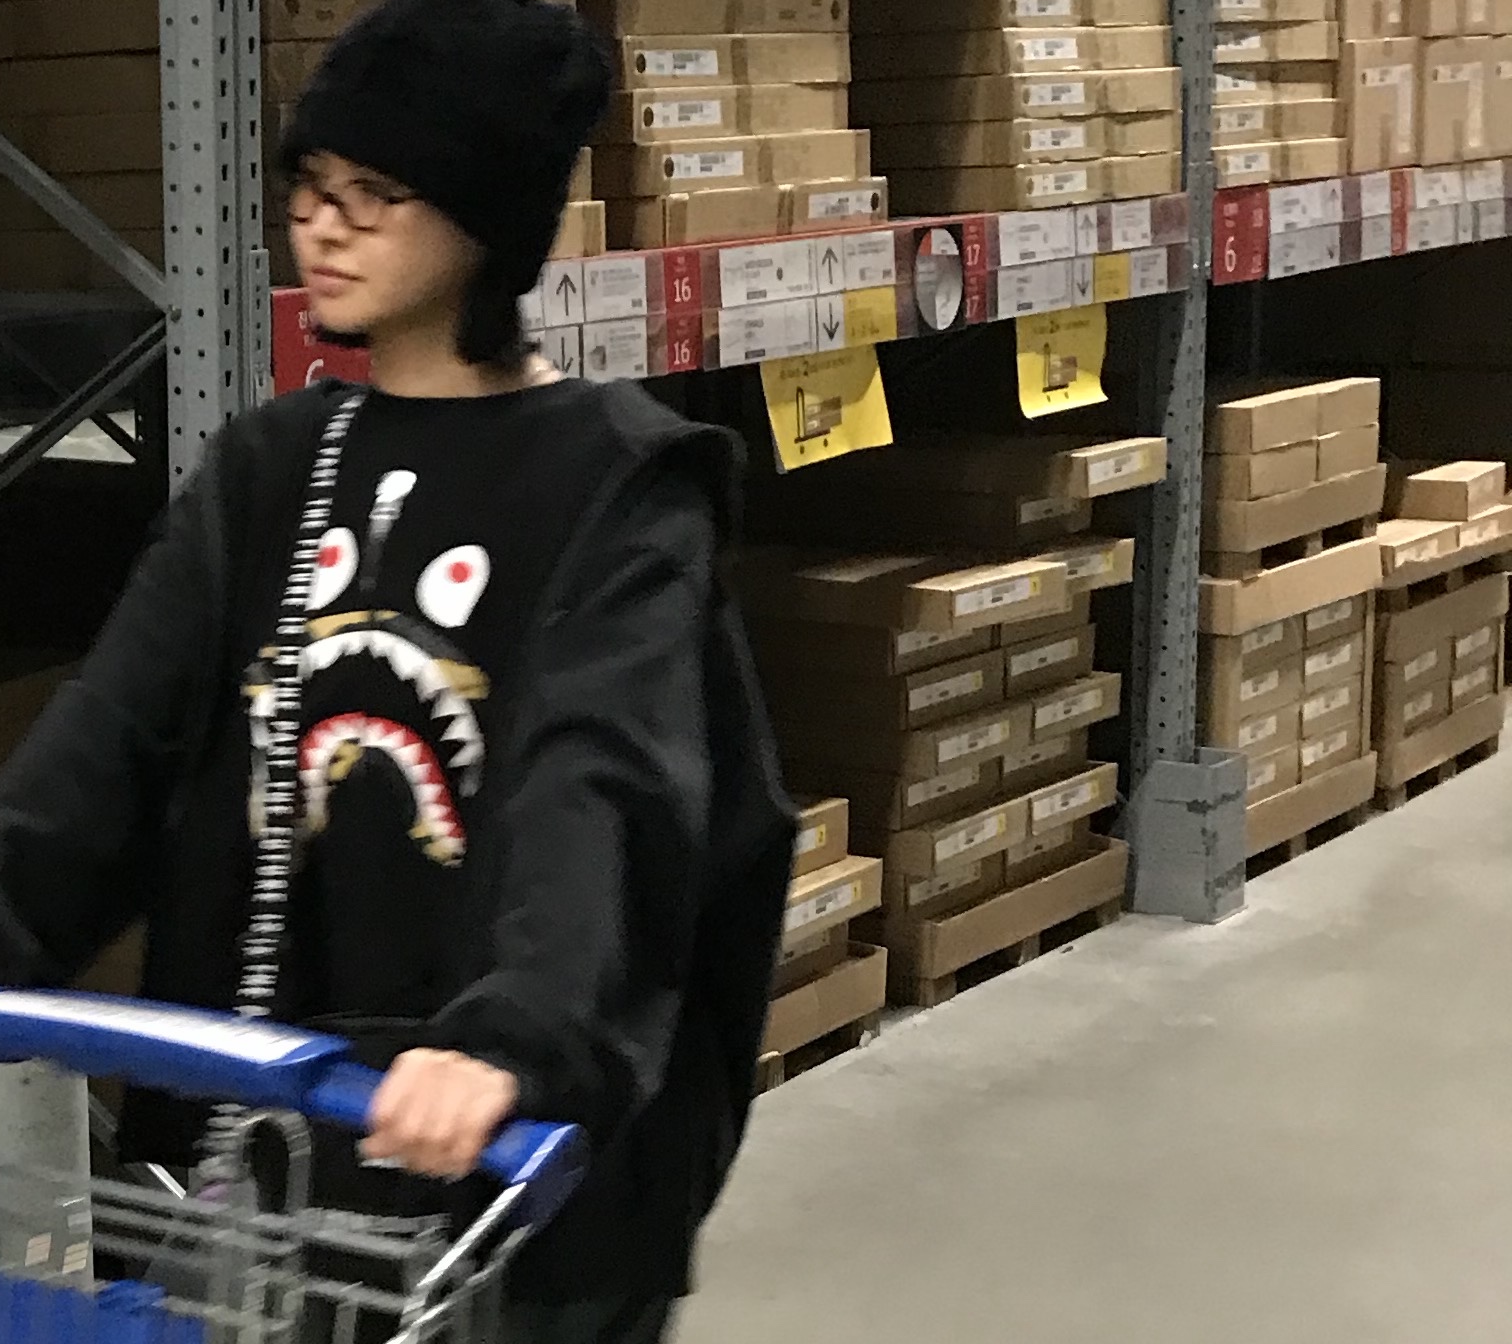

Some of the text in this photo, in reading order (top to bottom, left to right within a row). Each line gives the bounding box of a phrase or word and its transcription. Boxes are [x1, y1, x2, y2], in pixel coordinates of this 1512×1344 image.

[966, 244, 981, 266] 17
[1224, 236, 1236, 273] 6
[673, 276, 692, 303] 16
[673, 338, 691, 366] 16
